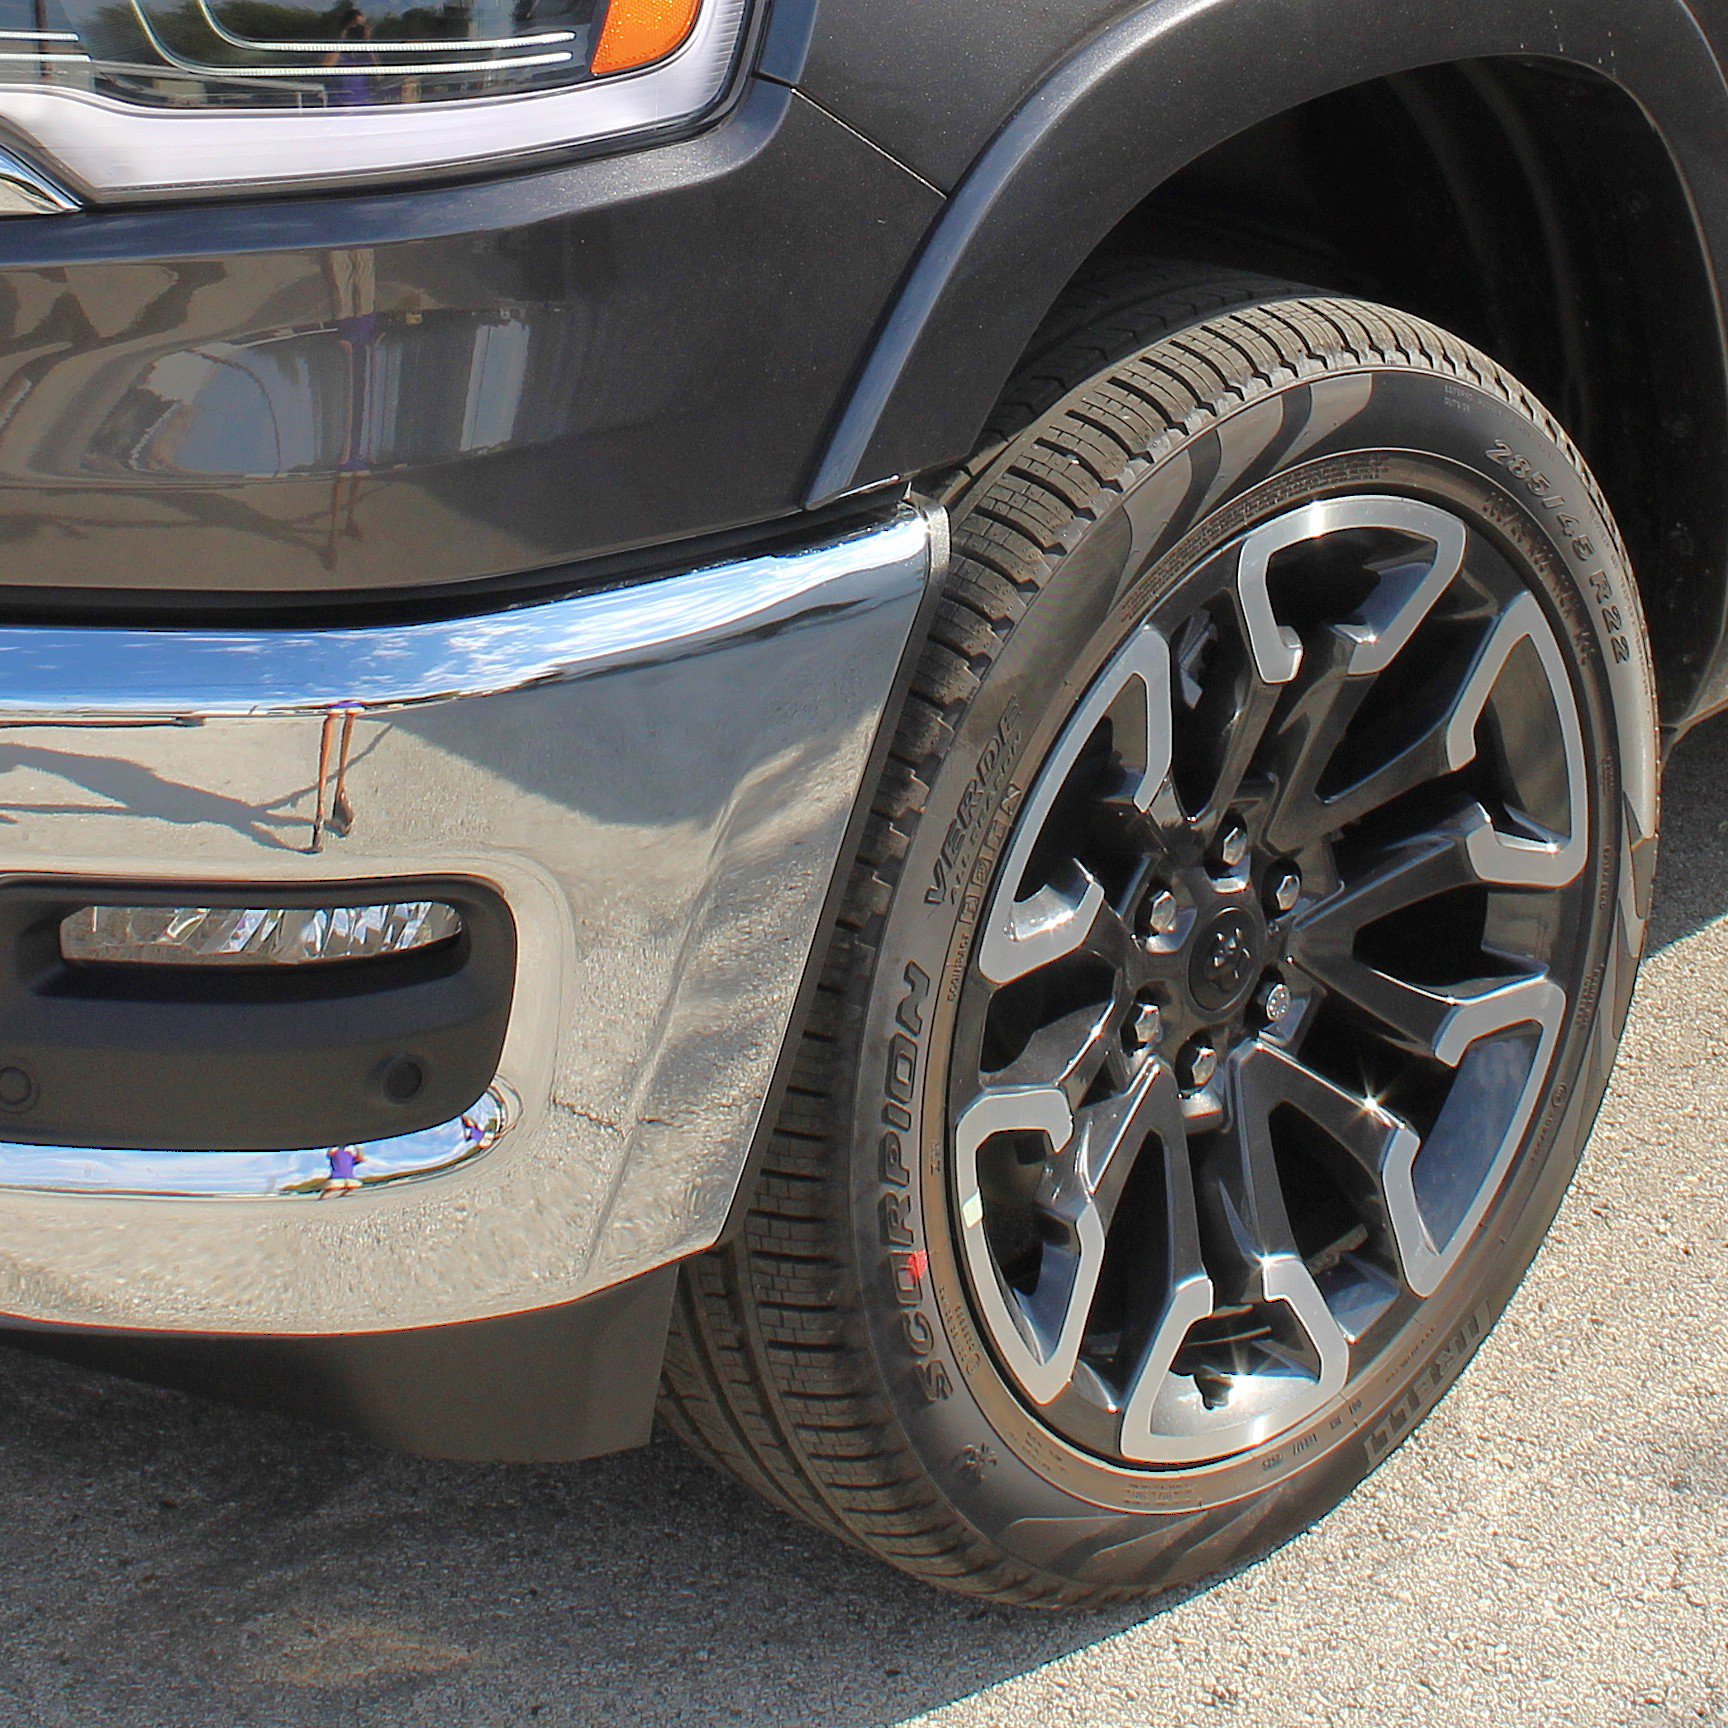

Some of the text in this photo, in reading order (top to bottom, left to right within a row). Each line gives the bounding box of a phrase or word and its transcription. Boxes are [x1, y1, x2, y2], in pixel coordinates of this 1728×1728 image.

[1485, 439, 1592, 563] 285/45
[1590, 570, 1633, 665] R22
[880, 694, 1023, 1402] SCORPION VERDE
